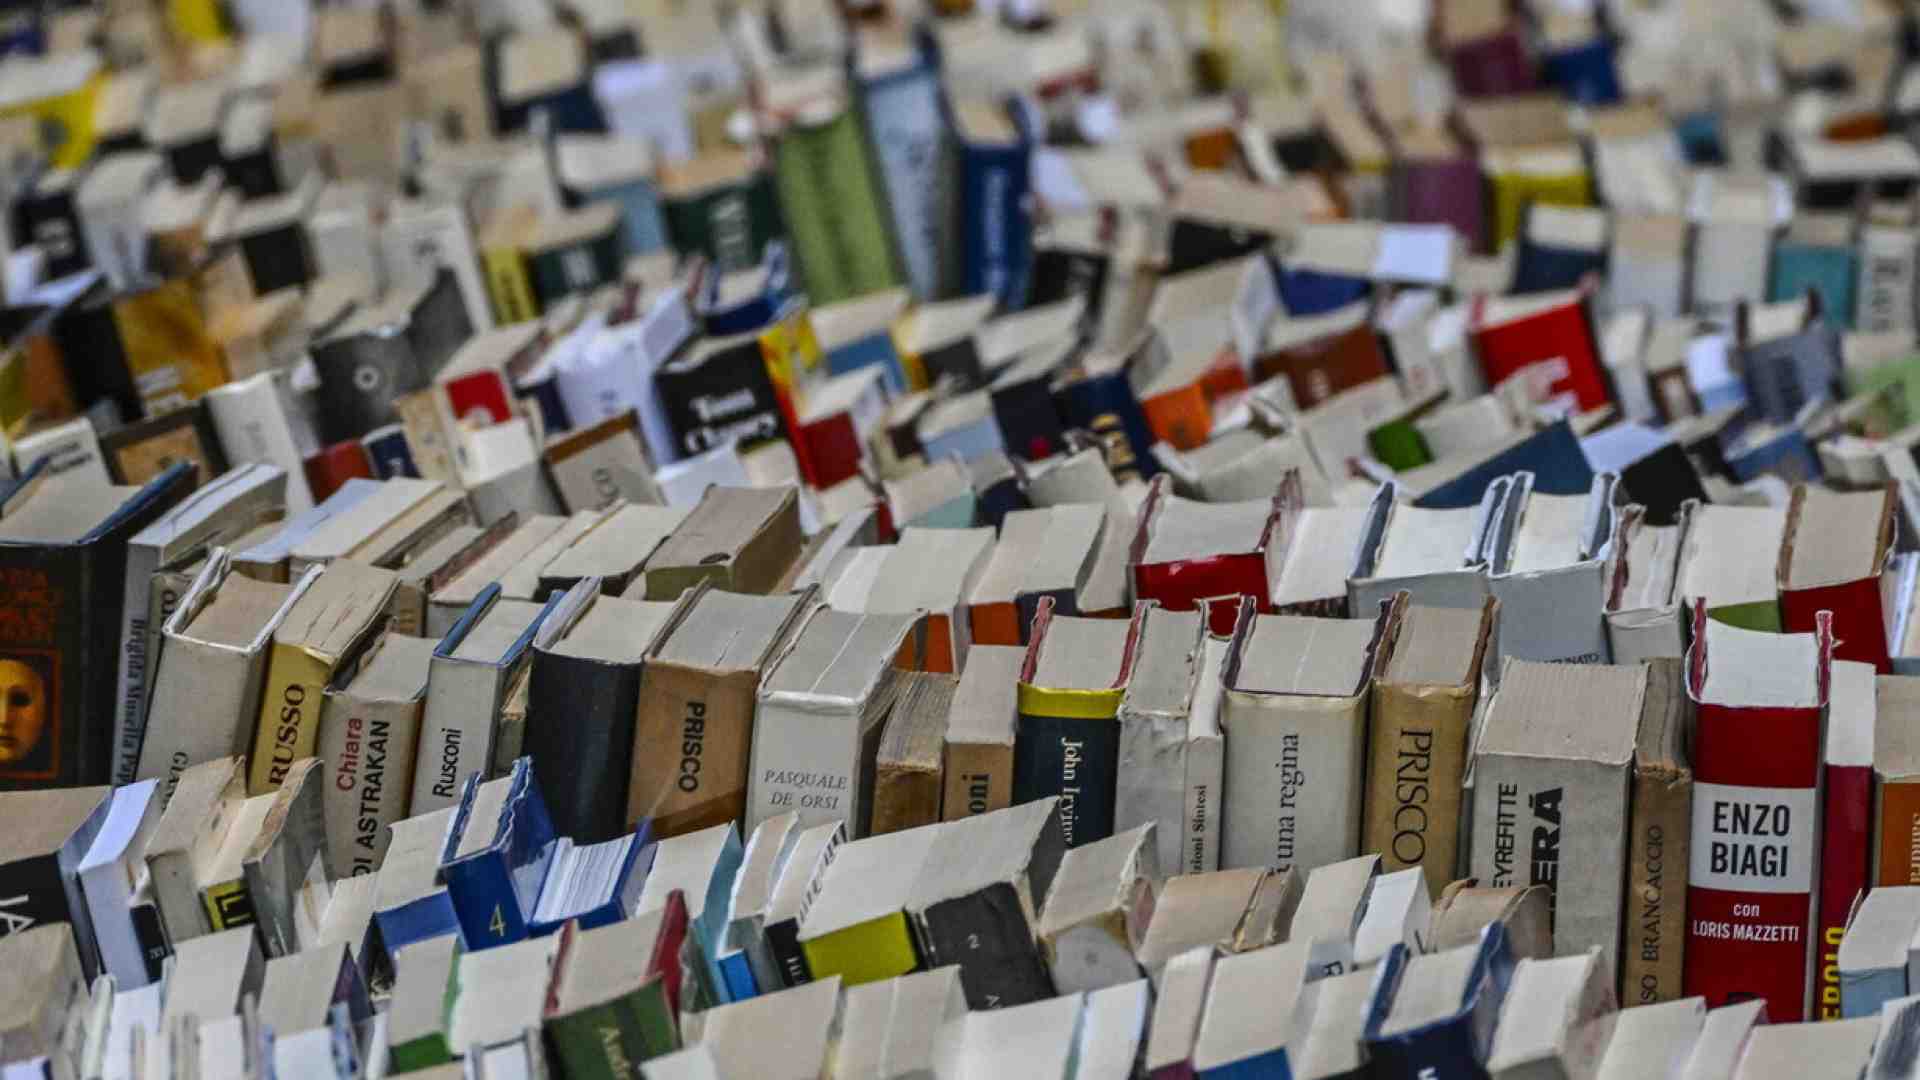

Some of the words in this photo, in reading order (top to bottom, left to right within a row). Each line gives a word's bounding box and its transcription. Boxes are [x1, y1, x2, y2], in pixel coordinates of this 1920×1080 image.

[269, 684, 305, 786] RUSSO
[336, 717, 363, 792] Chiara
[678, 701, 706, 792] PRISCO
[432, 727, 462, 798] Rusconi
[764, 769, 848, 790] PASQUALE
[1060, 737, 1083, 781] John
[1275, 733, 1304, 809] regina
[356, 720, 390, 850] ASTRAKAN
[769, 791, 793, 806] DE
[800, 794, 839, 810] ORSI
[962, 773, 989, 813] oni
[1391, 728, 1433, 865] PRISCO
[1277, 815, 1295, 860] una
[1712, 801, 1790, 837] ENZO
[1710, 841, 1789, 878] BIAGI
[1641, 823, 1664, 962] BRANCACCIO
[1733, 904, 1760, 917] con
[489, 903, 507, 937] 4
[1693, 919, 1730, 938] LORIS
[1732, 924, 1800, 943] MAZZETTI
[1641, 973, 1658, 1001] SO
